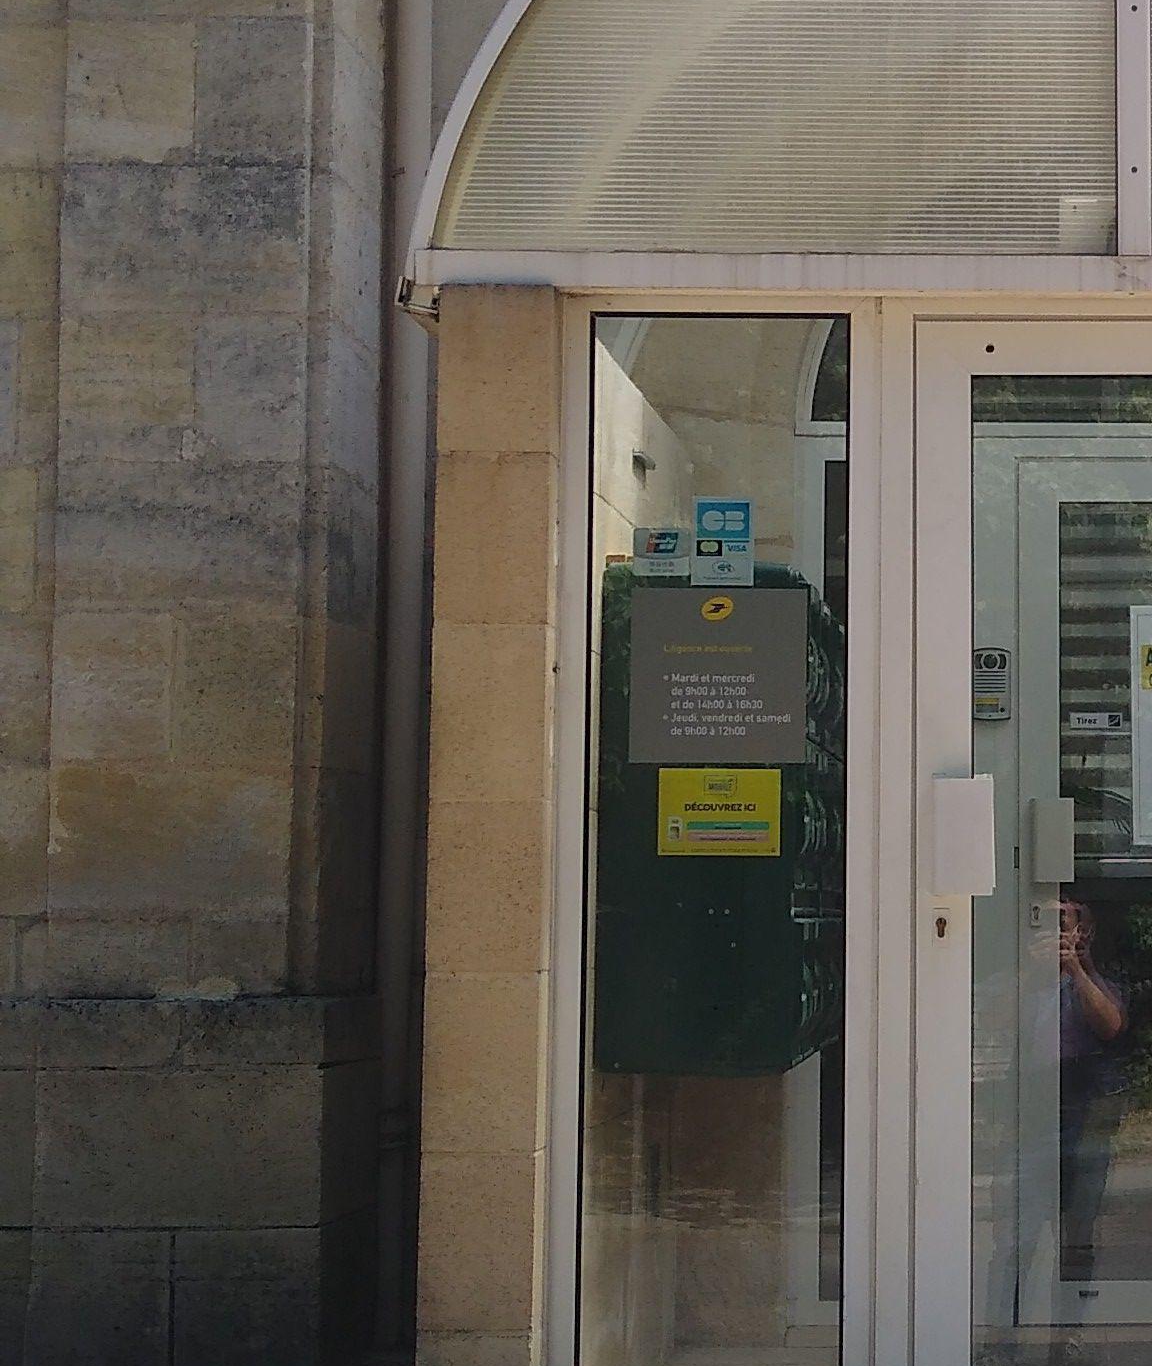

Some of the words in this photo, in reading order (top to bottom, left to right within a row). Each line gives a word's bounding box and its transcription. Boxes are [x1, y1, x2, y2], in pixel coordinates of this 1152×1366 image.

[726, 544, 747, 552] VISA
[670, 673, 699, 683] Mardi
[700, 673, 710, 683] et
[711, 673, 755, 683] mercredi
[670, 686, 683, 696] de
[685, 686, 708, 696] 9h00
[719, 686, 747, 696] 12h00
[670, 700, 680, 709] et
[682, 700, 695, 709] de
[698, 699, 725, 709] 14h00
[670, 713, 699, 723] Jeudi,
[701, 713, 743, 723] vendredi
[744, 713, 754, 723] et
[756, 713, 792, 723] samedi
[1076, 717, 1097, 725] Tirez
[670, 726, 682, 736] de
[684, 726, 708, 736] 9h00
[718, 726, 746, 736] 12h00
[684, 801, 742, 812] DÉCOUVREZ
[743, 803, 756, 812] ICI
